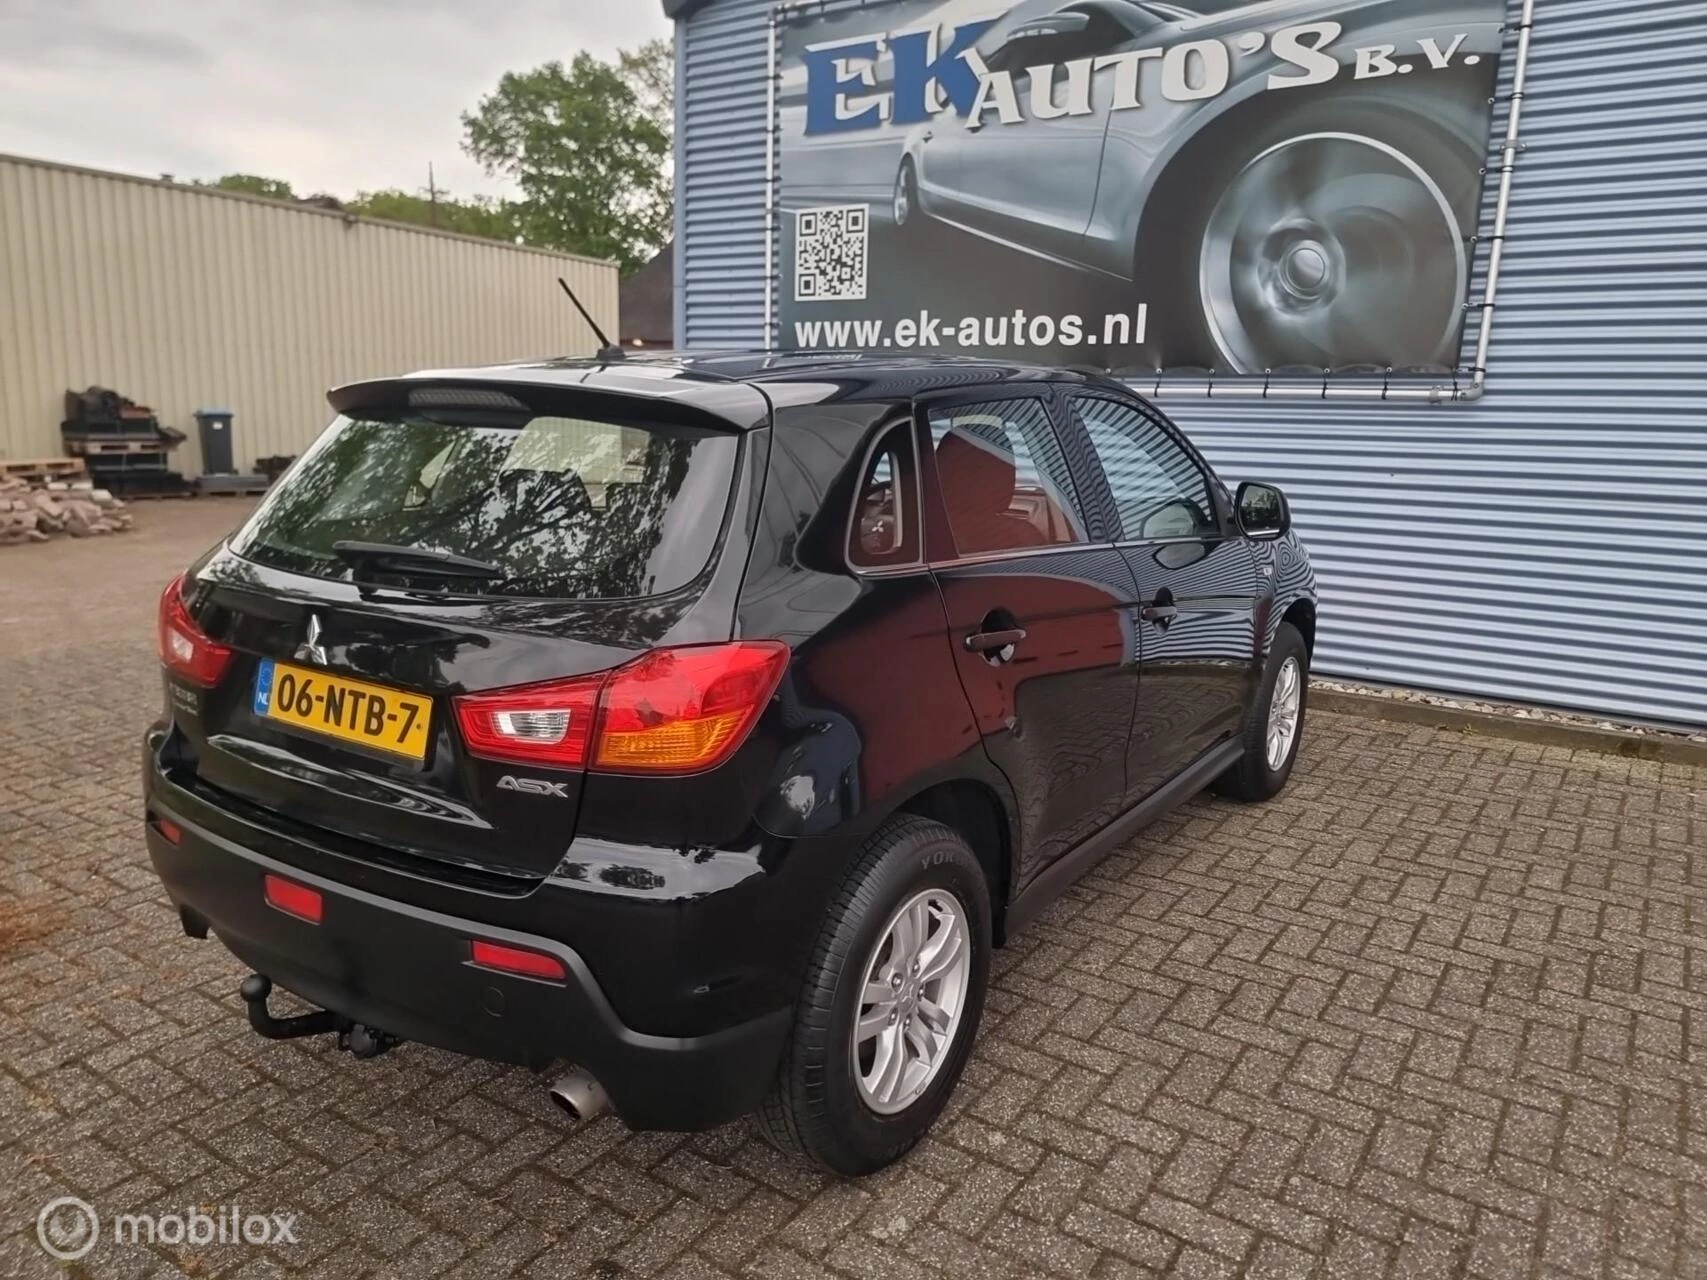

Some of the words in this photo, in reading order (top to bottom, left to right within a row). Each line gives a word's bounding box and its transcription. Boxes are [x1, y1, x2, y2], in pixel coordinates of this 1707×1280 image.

[803, 18, 1003, 136] EK
[955, 22, 1342, 129] AUTO'S
[1354, 33, 1480, 79] B.V.
[794, 303, 1148, 347] www.ek-autos.nl
[256, 692, 268, 705] NL
[277, 673, 419, 744] 06-NTB-7
[496, 775, 568, 798] ASX
